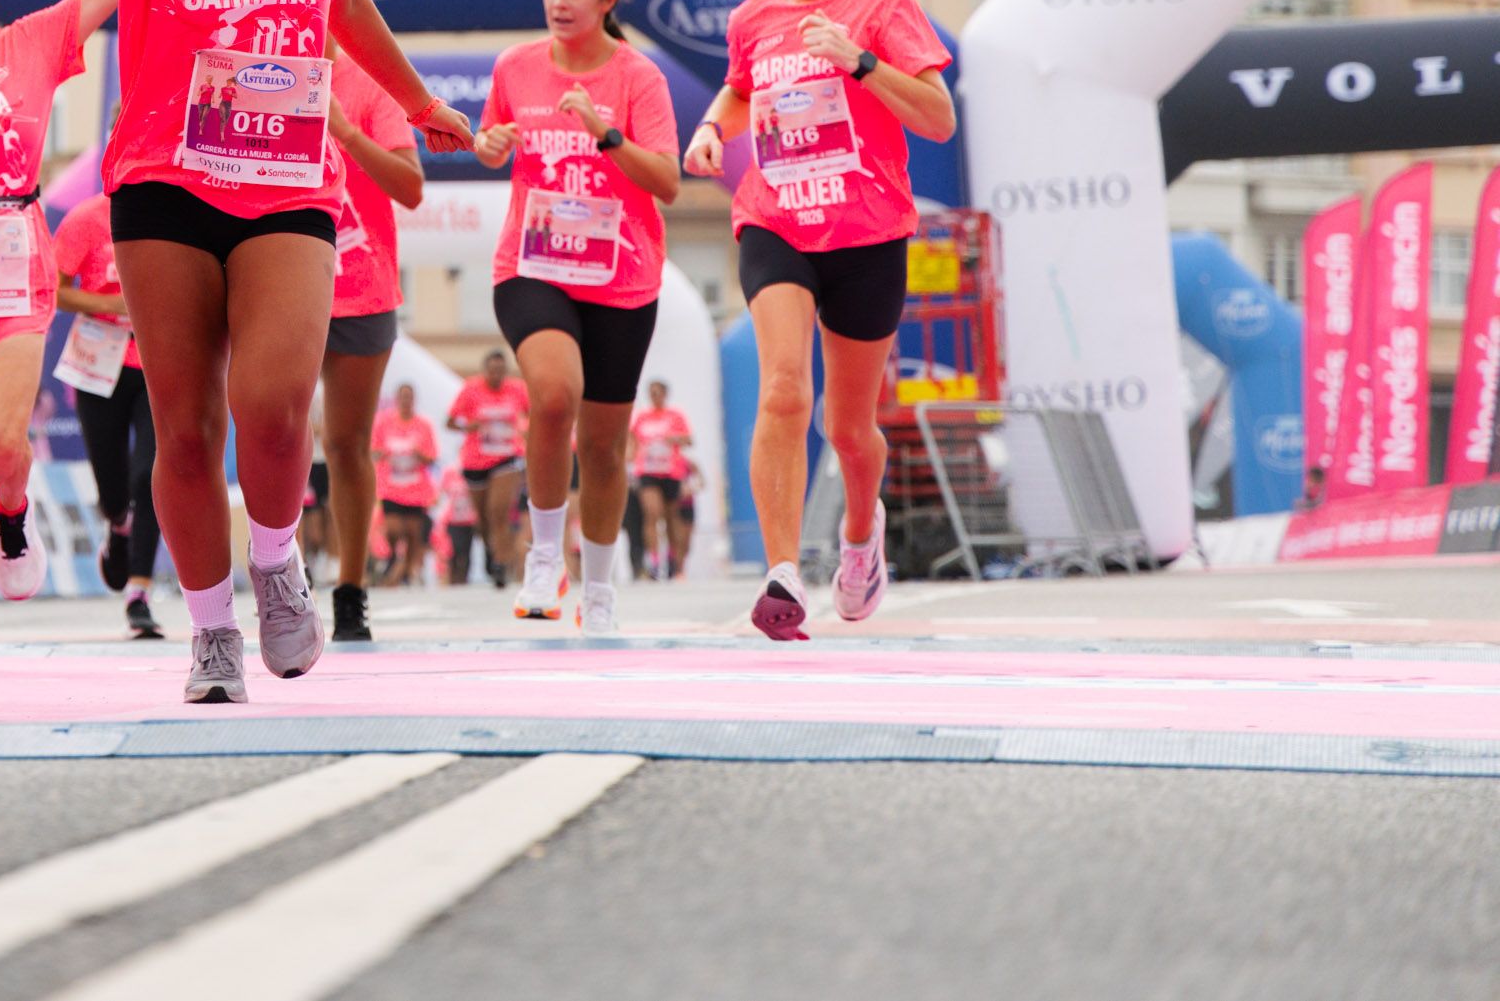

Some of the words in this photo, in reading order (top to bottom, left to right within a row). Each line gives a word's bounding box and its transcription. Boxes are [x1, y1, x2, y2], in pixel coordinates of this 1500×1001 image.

[207, 59, 234, 72] SUMA
[240, 71, 292, 87] ASTURIANA
[1230, 50, 1500, 108] VOL
[233, 111, 285, 136] 016
[245, 137, 269, 149] 1013
[781, 125, 820, 147] 016
[195, 142, 227, 156] CARRERA
[228, 147, 238, 157] DE
[239, 148, 248, 158] LA
[249, 149, 273, 159] MUJER
[276, 152, 282, 160] A
[283, 152, 310, 162] CORUÑA
[267, 168, 307, 179] Santander
[563, 162, 592, 196] DE
[990, 172, 1133, 218] OYSHO
[797, 209, 826, 226] 2026
[551, 232, 588, 252] 016
[1376, 325, 1419, 472] Nordés
